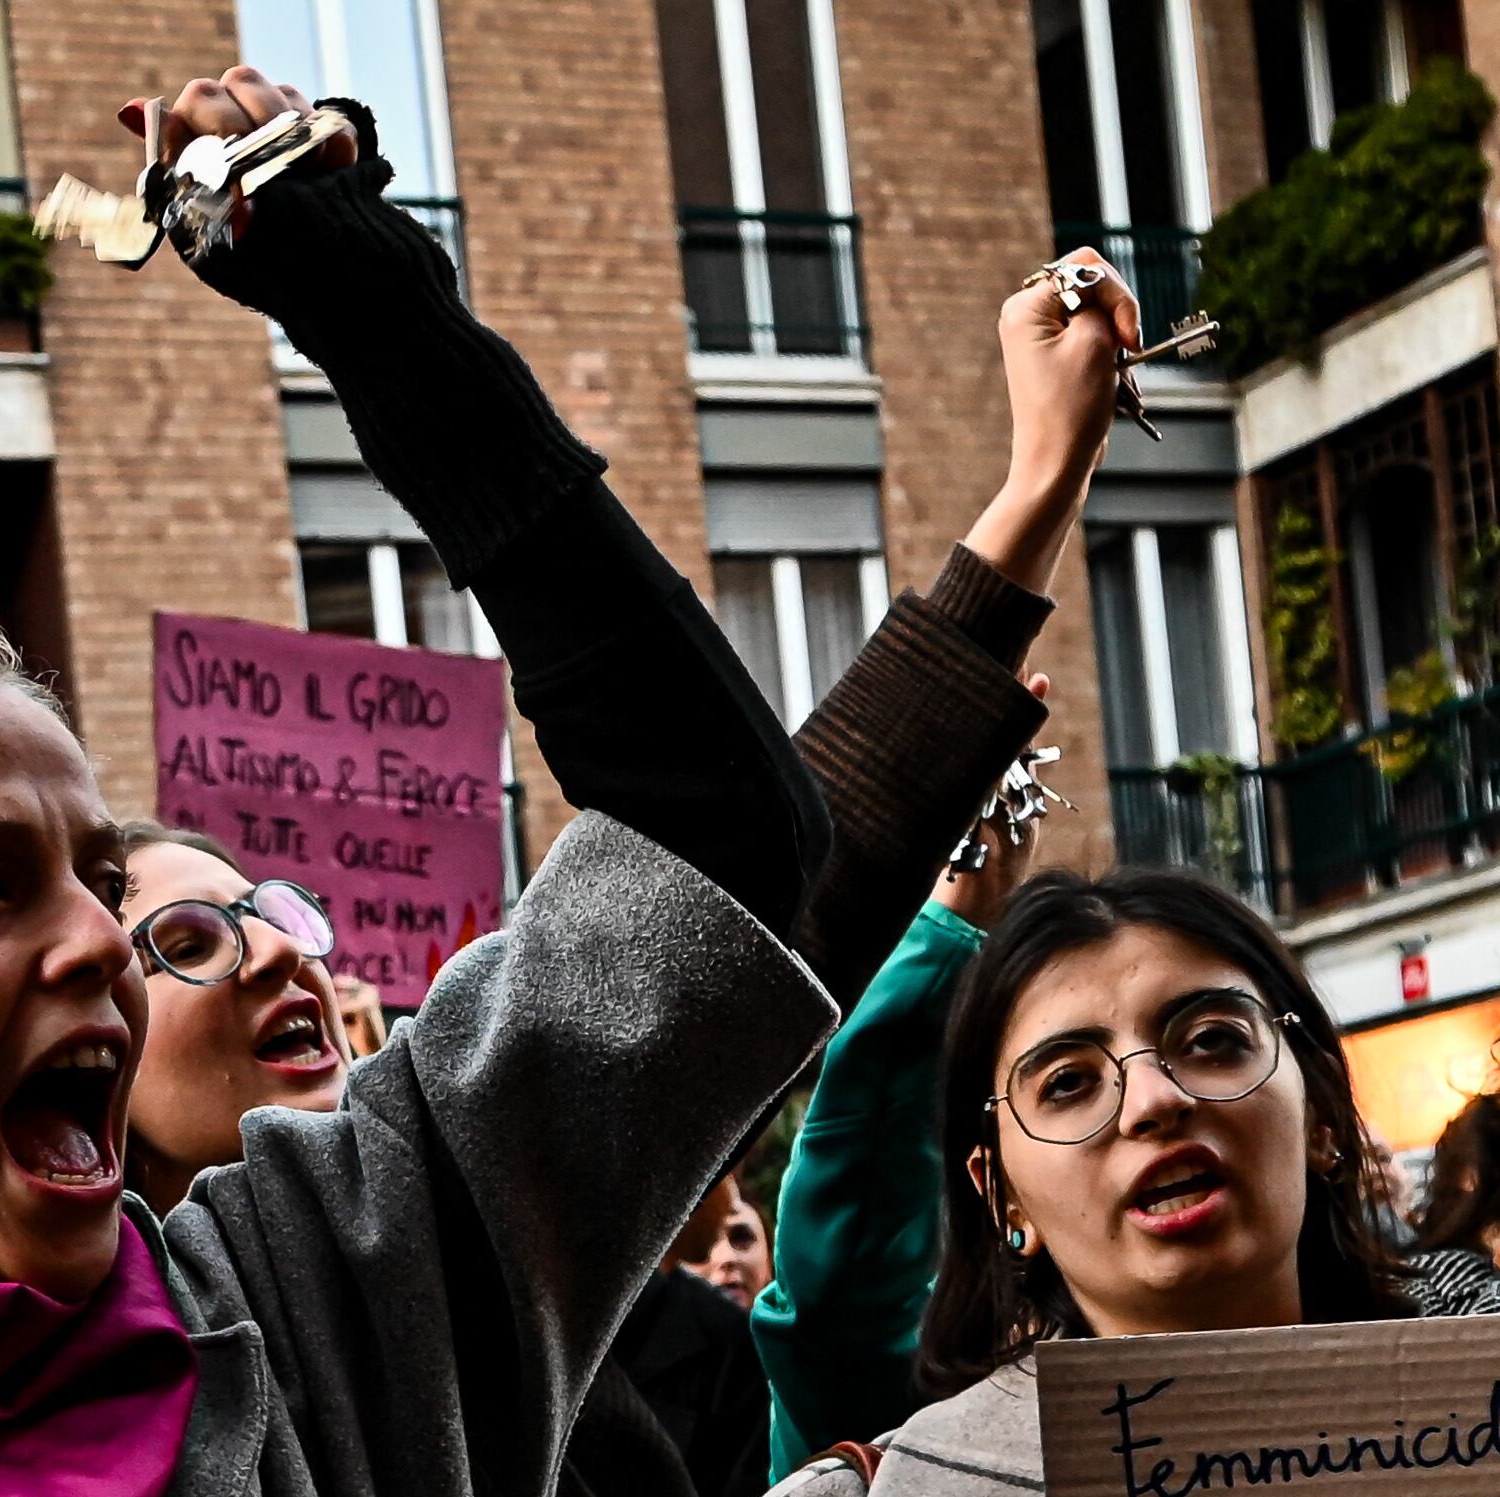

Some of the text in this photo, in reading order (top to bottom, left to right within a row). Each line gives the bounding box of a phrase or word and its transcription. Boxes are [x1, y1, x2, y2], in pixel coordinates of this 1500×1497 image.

[163, 629, 451, 732] SIAMO IL GRIDO
[235, 809, 311, 864] TUTTE
